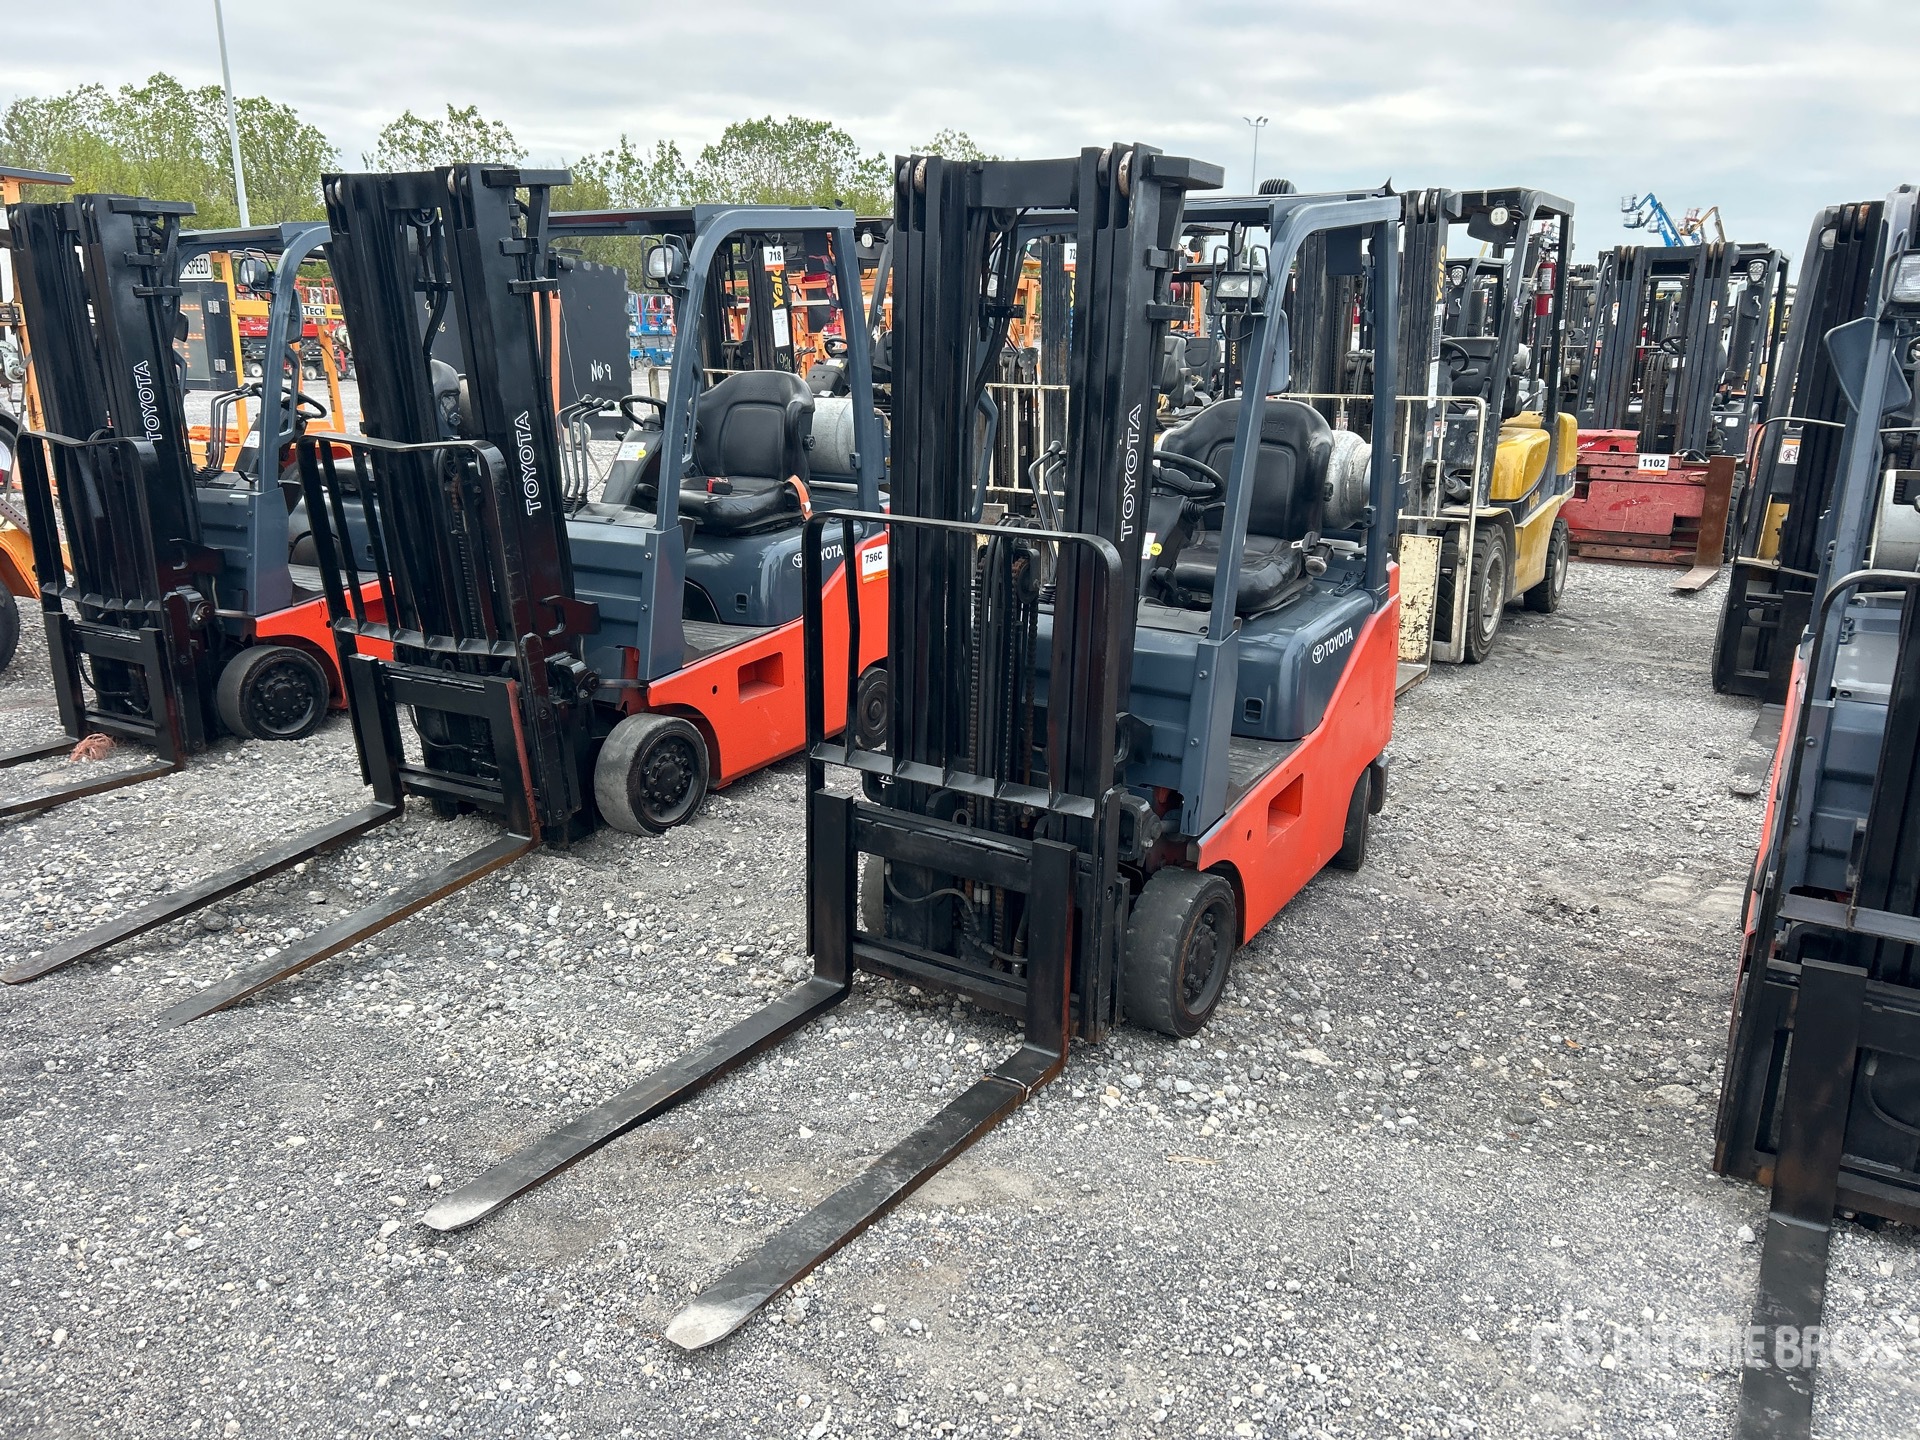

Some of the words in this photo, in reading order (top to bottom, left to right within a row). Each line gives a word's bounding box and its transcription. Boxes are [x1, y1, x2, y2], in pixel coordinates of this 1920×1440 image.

[768, 251, 782, 262] 718
[133, 360, 163, 444] TOYOTA
[514, 410, 542, 516] TOYOTA
[1120, 403, 1142, 542] TOYOTA
[1641, 458, 1667, 468] 1102
[820, 544, 845, 561] YOTA
[864, 551, 883, 564] 756C
[1324, 626, 1354, 657] TOYOTA
